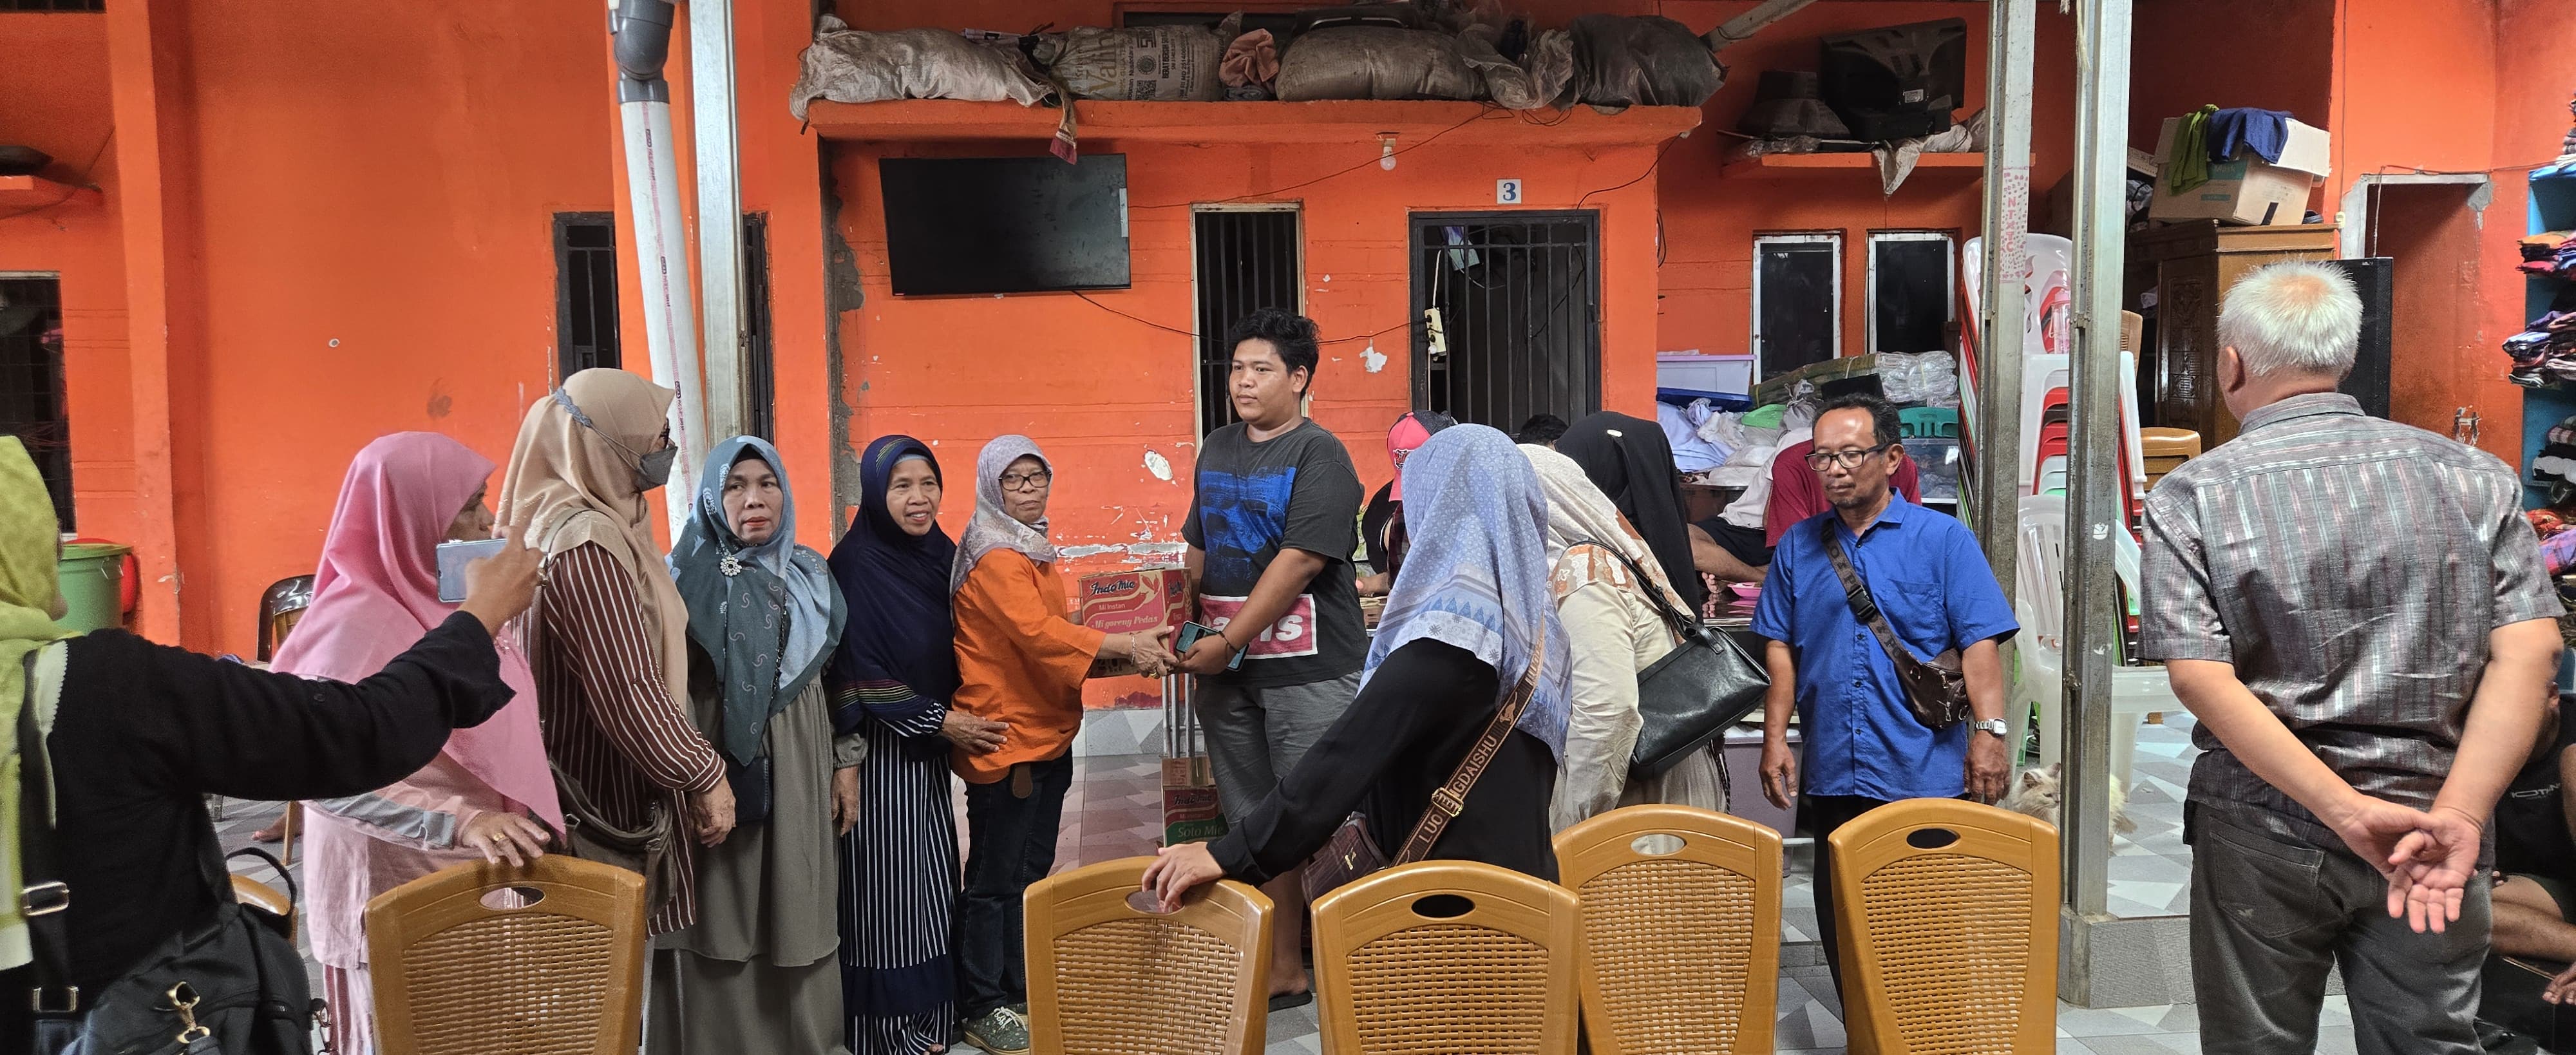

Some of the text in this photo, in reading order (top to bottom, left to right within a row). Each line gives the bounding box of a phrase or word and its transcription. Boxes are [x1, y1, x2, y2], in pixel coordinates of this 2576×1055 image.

[1502, 182, 1517, 201] 3
[1104, 618, 1132, 629] goreng
[1133, 615, 1158, 624] Pedas
[1178, 826, 1202, 837] Soto
